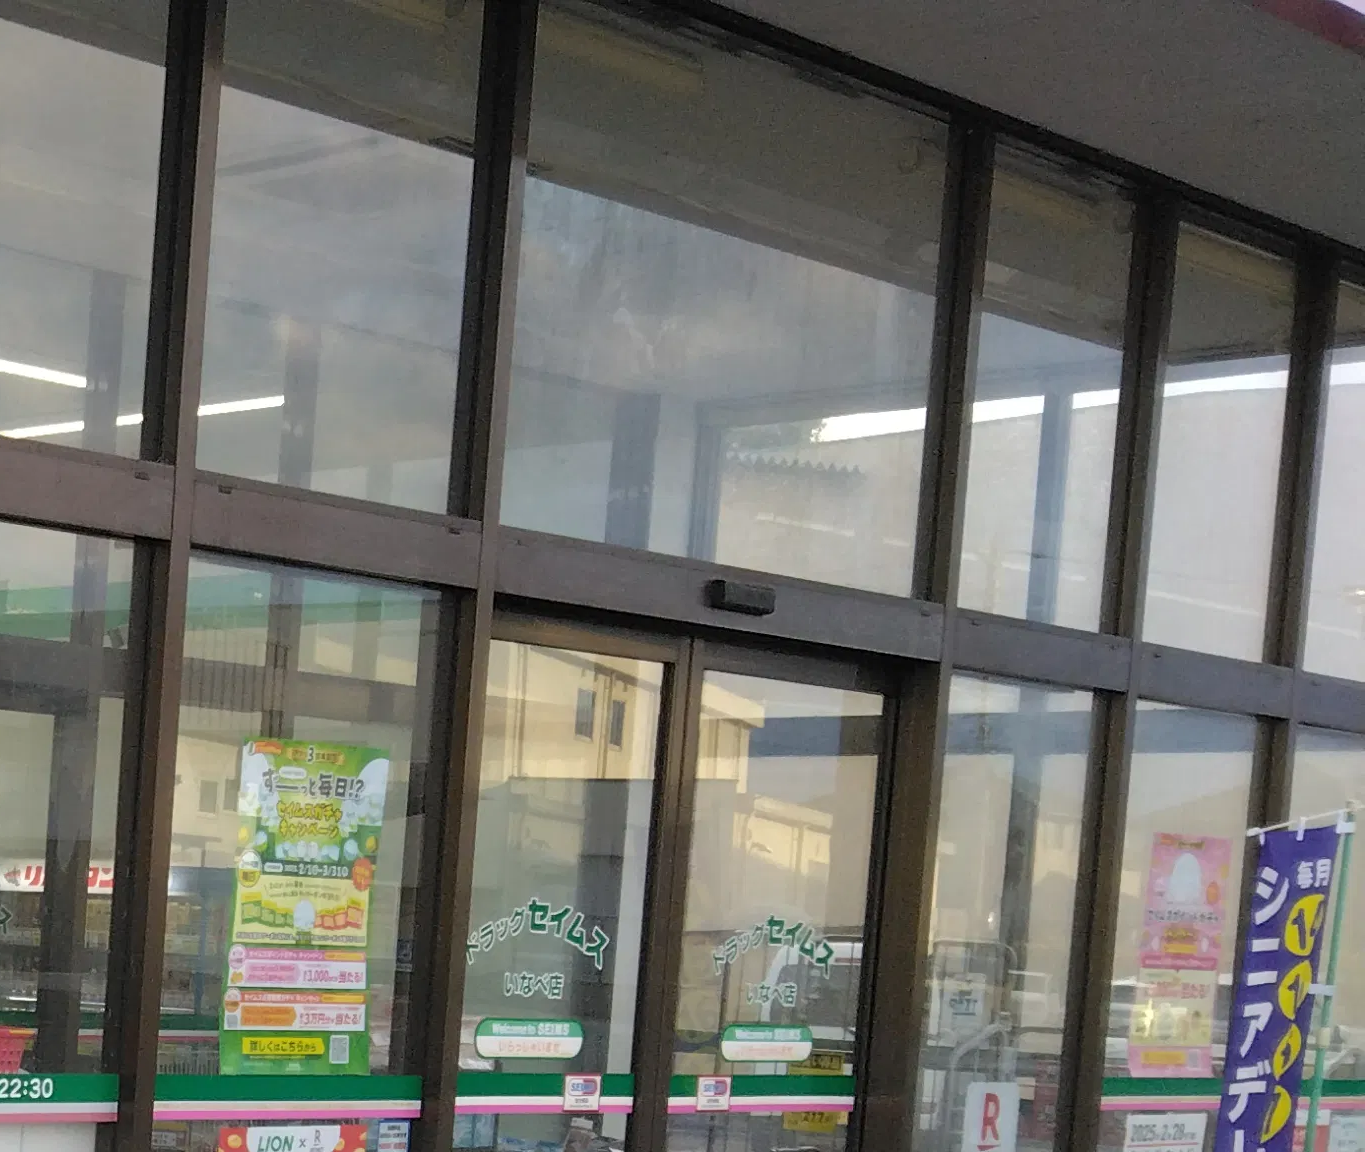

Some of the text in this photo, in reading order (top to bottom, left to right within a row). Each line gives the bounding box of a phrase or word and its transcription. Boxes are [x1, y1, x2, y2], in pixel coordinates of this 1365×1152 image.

[466, 897, 610, 970] ドラッグセイムス
[712, 914, 835, 980] ドラッグセイムス
[503, 971, 564, 999] いなべ店
[745, 982, 798, 1007] いなべ店
[980, 1092, 1000, 1142] R
[257, 1135, 295, 1152] LION
